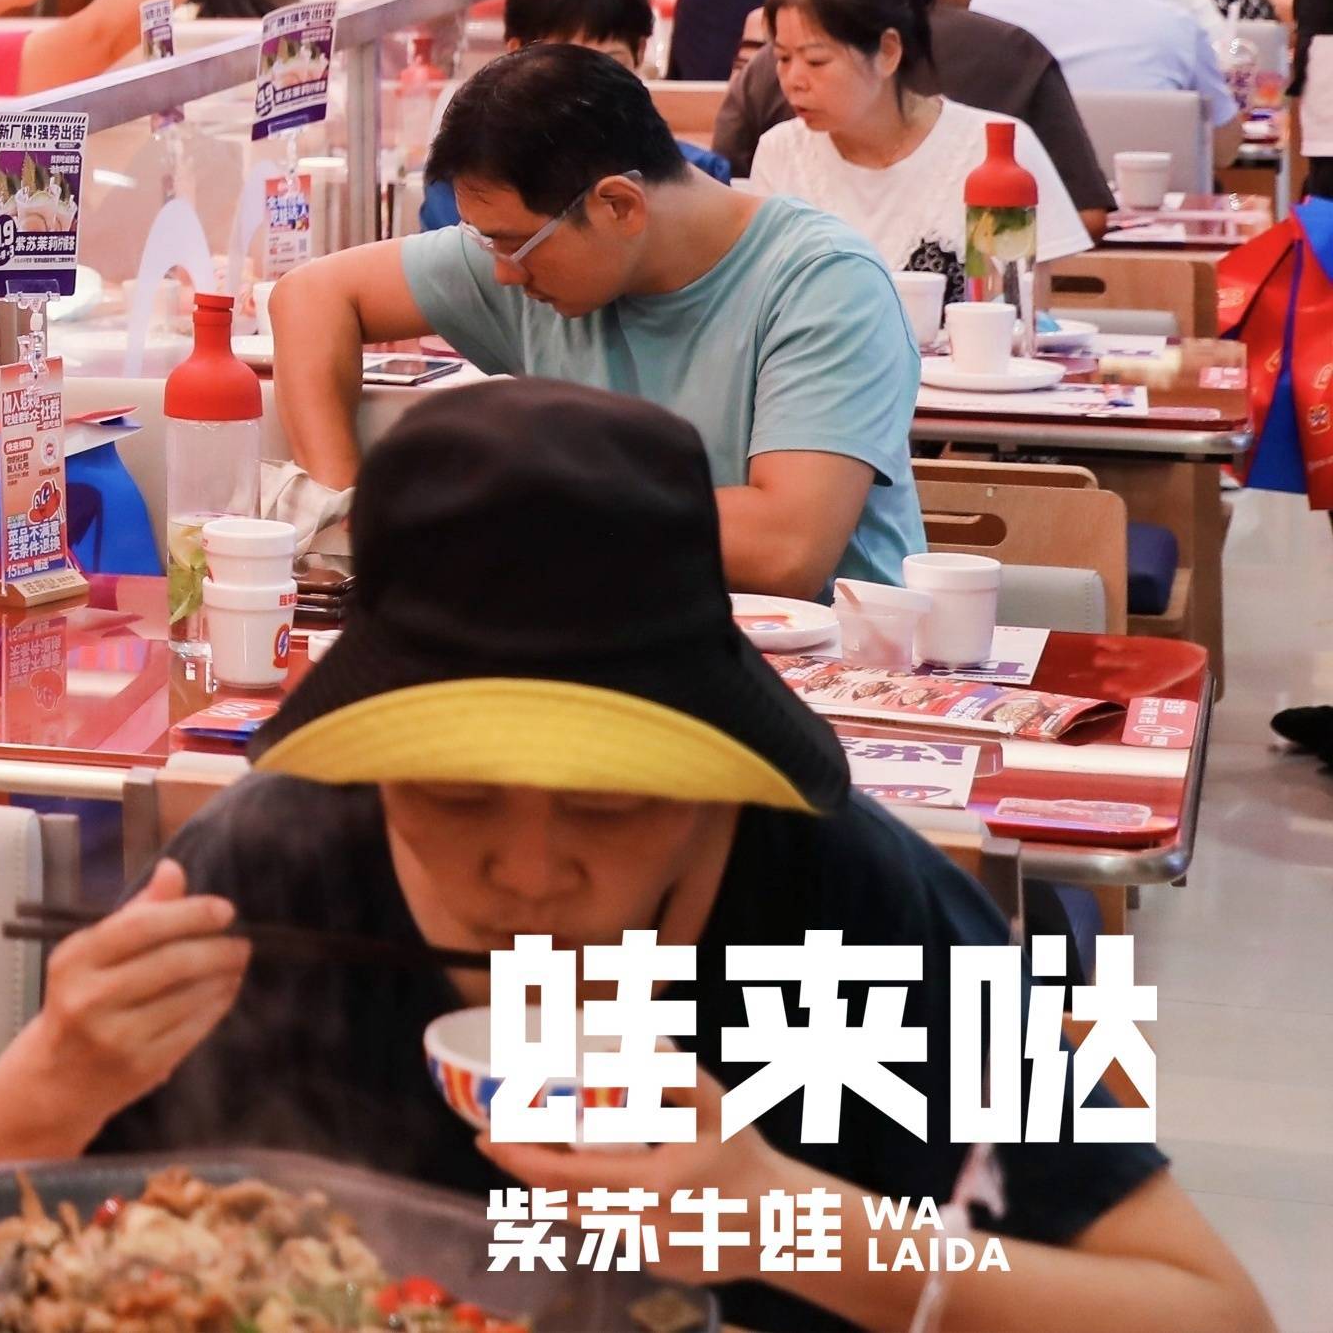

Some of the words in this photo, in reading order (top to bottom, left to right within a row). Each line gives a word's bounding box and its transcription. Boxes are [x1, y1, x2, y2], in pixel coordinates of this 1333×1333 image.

[0, 124, 85, 141] 新厂牌!强势出街
[8, 521, 60, 546] 菜品不满意
[9, 536, 61, 561] 无条件退换
